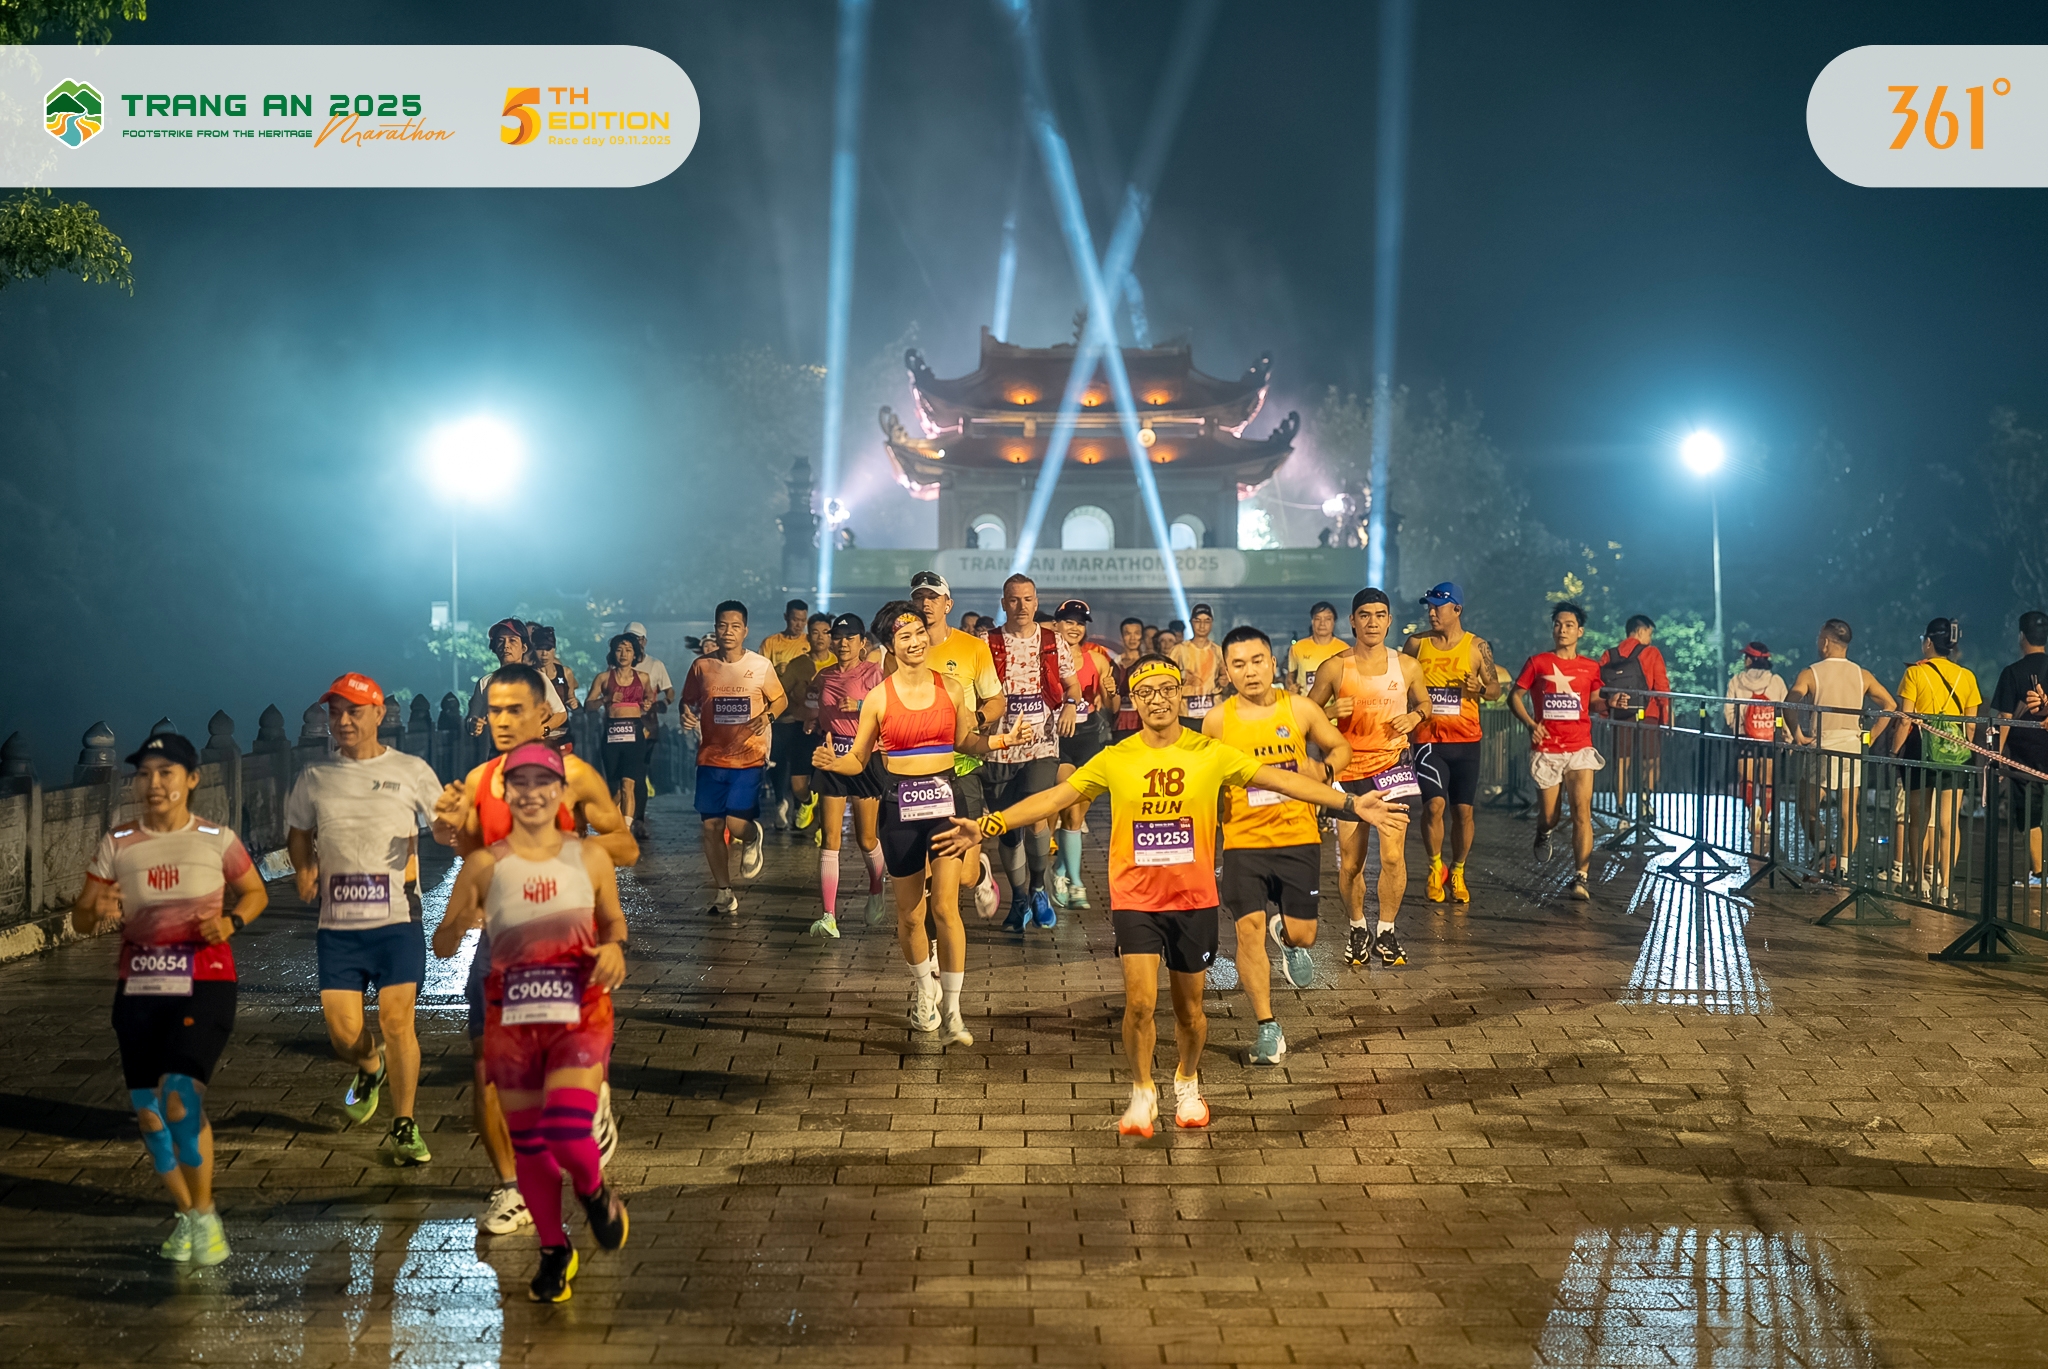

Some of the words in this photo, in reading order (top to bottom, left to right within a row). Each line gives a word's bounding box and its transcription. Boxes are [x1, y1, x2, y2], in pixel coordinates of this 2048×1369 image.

[1176, 557, 1219, 571] 2025
[715, 704, 749, 713] B90833
[1010, 701, 1043, 712] C91615
[1545, 699, 1578, 709] C90525
[1378, 771, 1414, 788] B90832
[902, 788, 949, 803] C90852
[1141, 800, 1183, 815] RUN
[1137, 830, 1190, 846] C91253
[334, 884, 386, 901] C90023
[131, 955, 188, 971] C90654
[508, 981, 574, 1000] C90652
